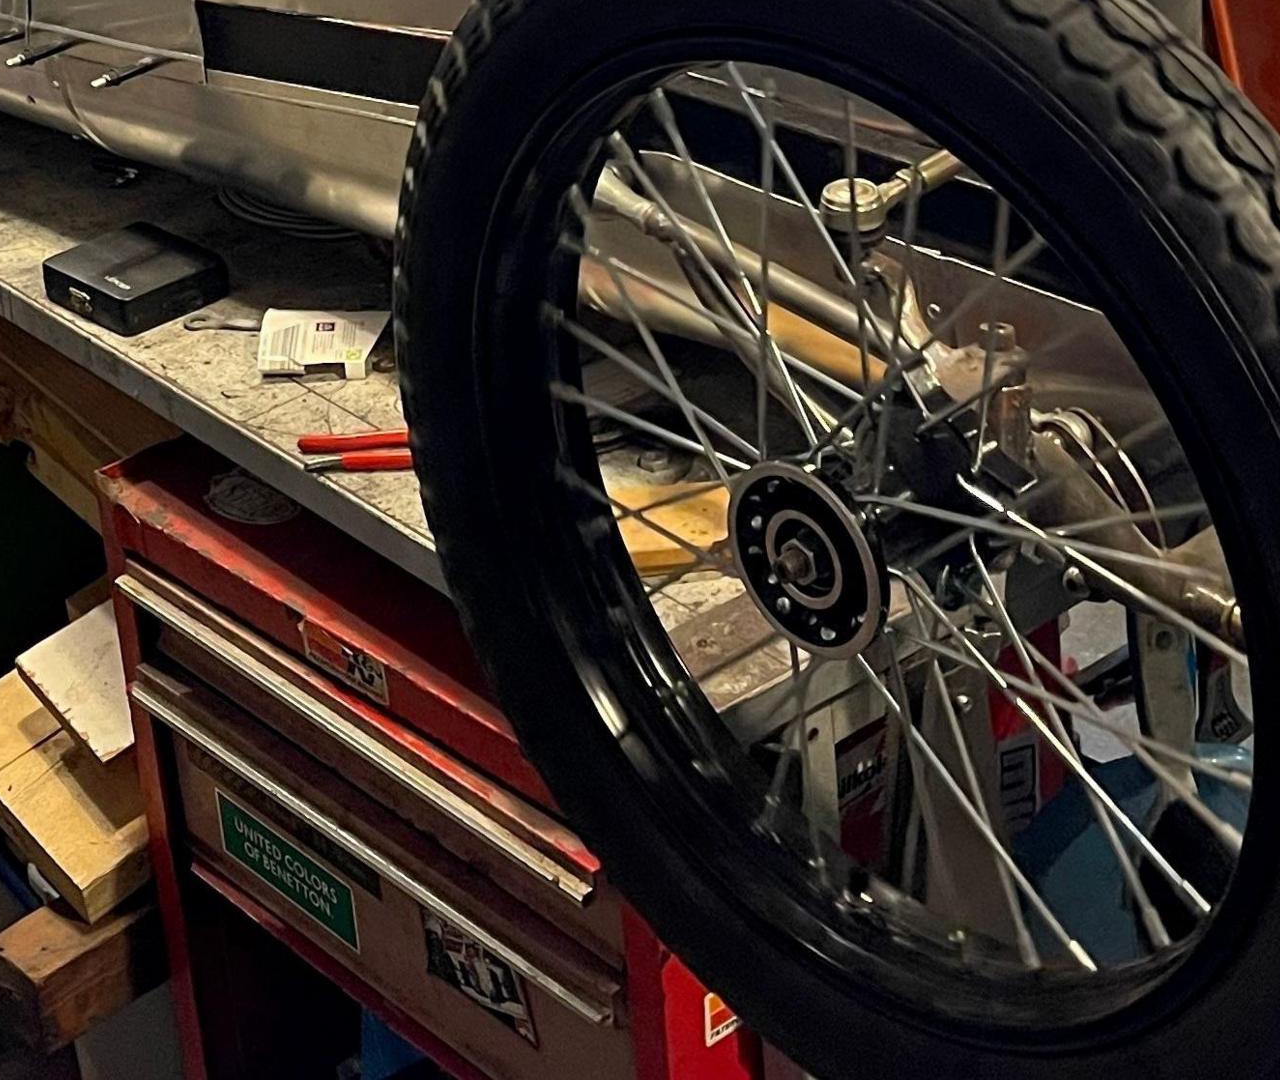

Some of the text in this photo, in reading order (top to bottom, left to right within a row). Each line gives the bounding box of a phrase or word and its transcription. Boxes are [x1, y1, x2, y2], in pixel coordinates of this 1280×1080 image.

[234, 816, 338, 904] UNITED COLORS
[244, 841, 260, 861] OF
